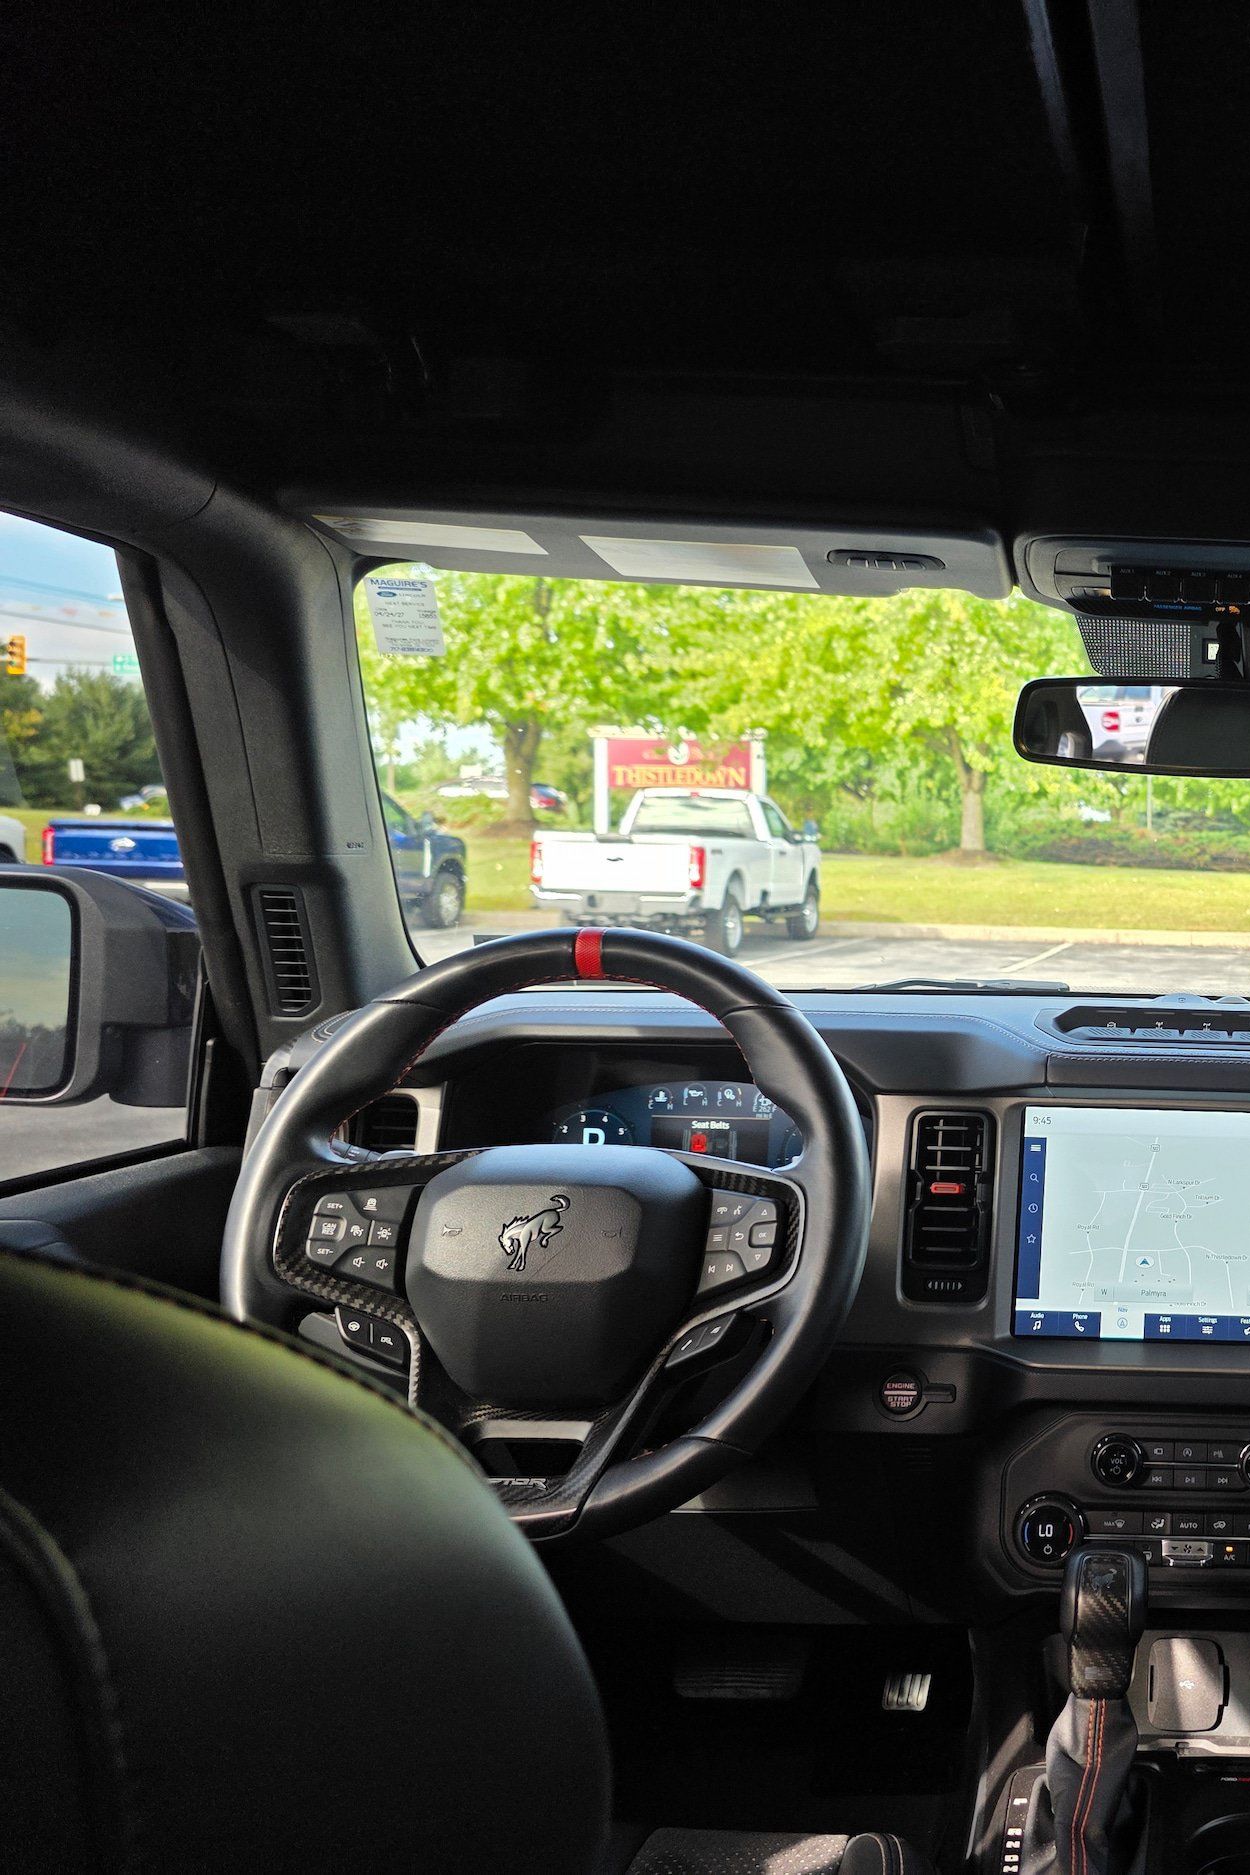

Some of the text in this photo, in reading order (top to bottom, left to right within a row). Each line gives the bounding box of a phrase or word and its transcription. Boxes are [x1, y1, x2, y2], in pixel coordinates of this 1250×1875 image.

[370, 579, 428, 588] MAGUIRE'S
[613, 765, 746, 788] THISTLEDOWN
[692, 1121, 709, 1129] Seat
[1032, 1116, 1052, 1125] 9:45
[562, 1125, 568, 1133] 2
[500, 1293, 548, 1302] AIRBAG
[1038, 1524, 1053, 1538] LO
